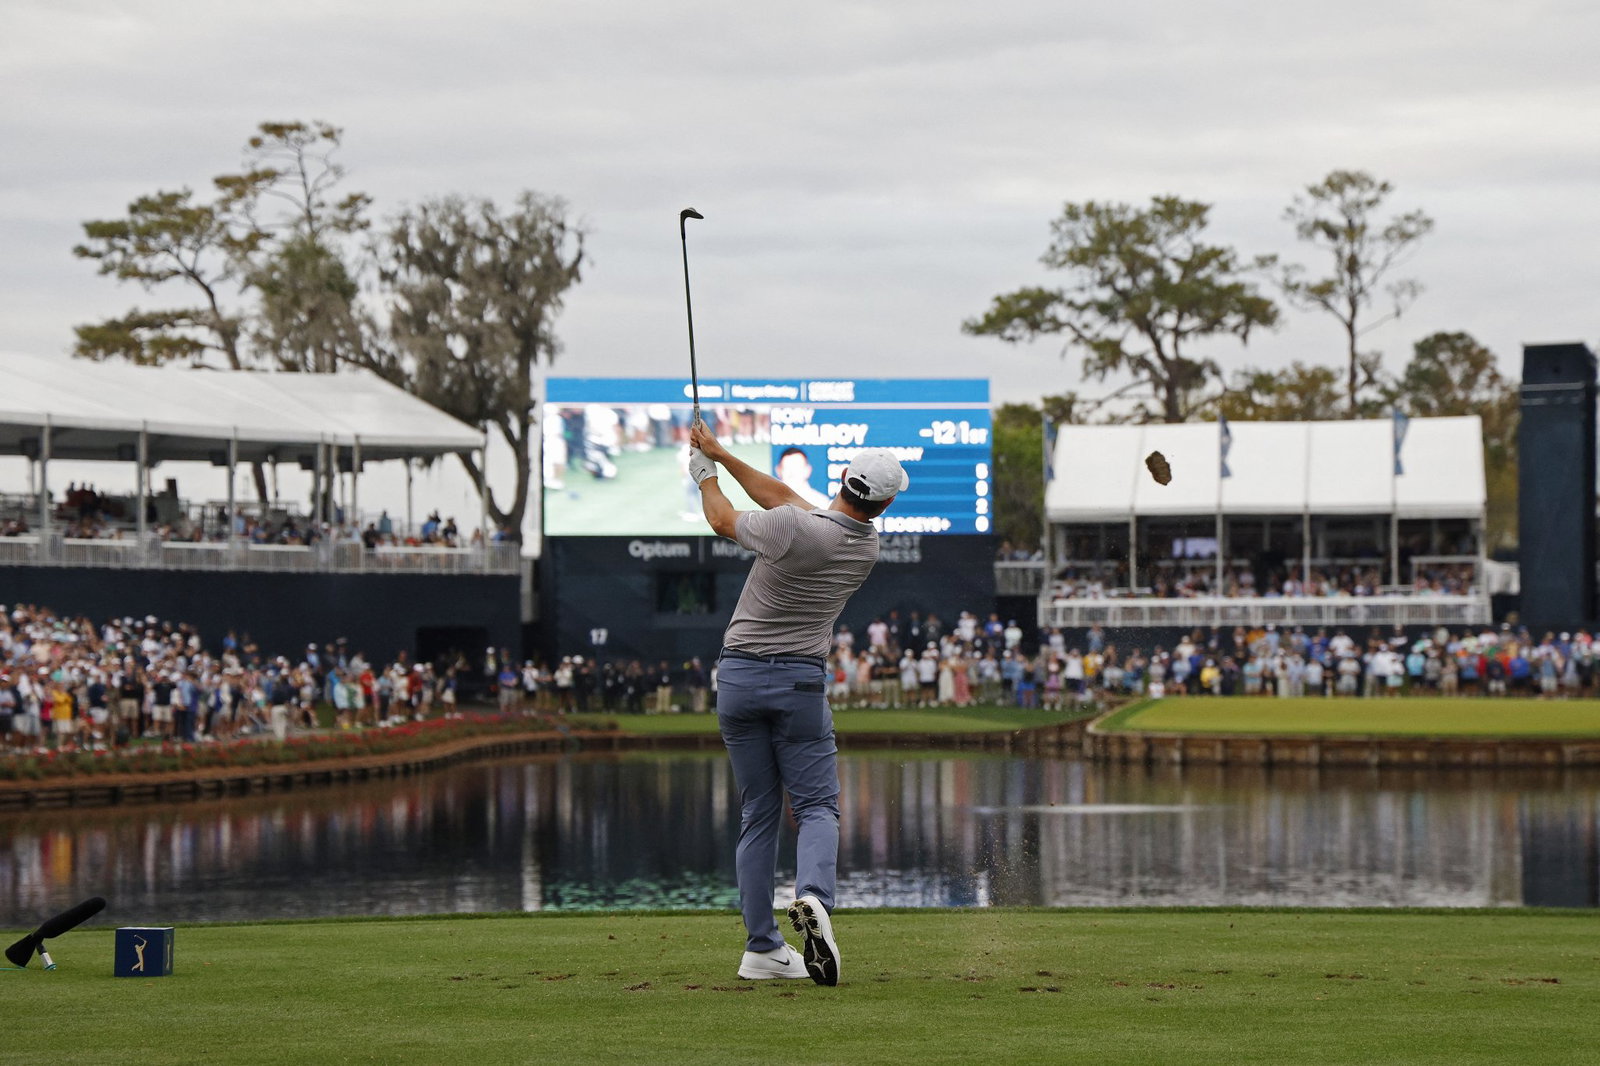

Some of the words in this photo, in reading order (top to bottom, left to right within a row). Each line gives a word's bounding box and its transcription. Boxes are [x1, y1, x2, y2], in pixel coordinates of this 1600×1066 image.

[879, 533, 921, 548] CAST
[628, 540, 691, 561] Optum
[590, 628, 608, 645] 17
